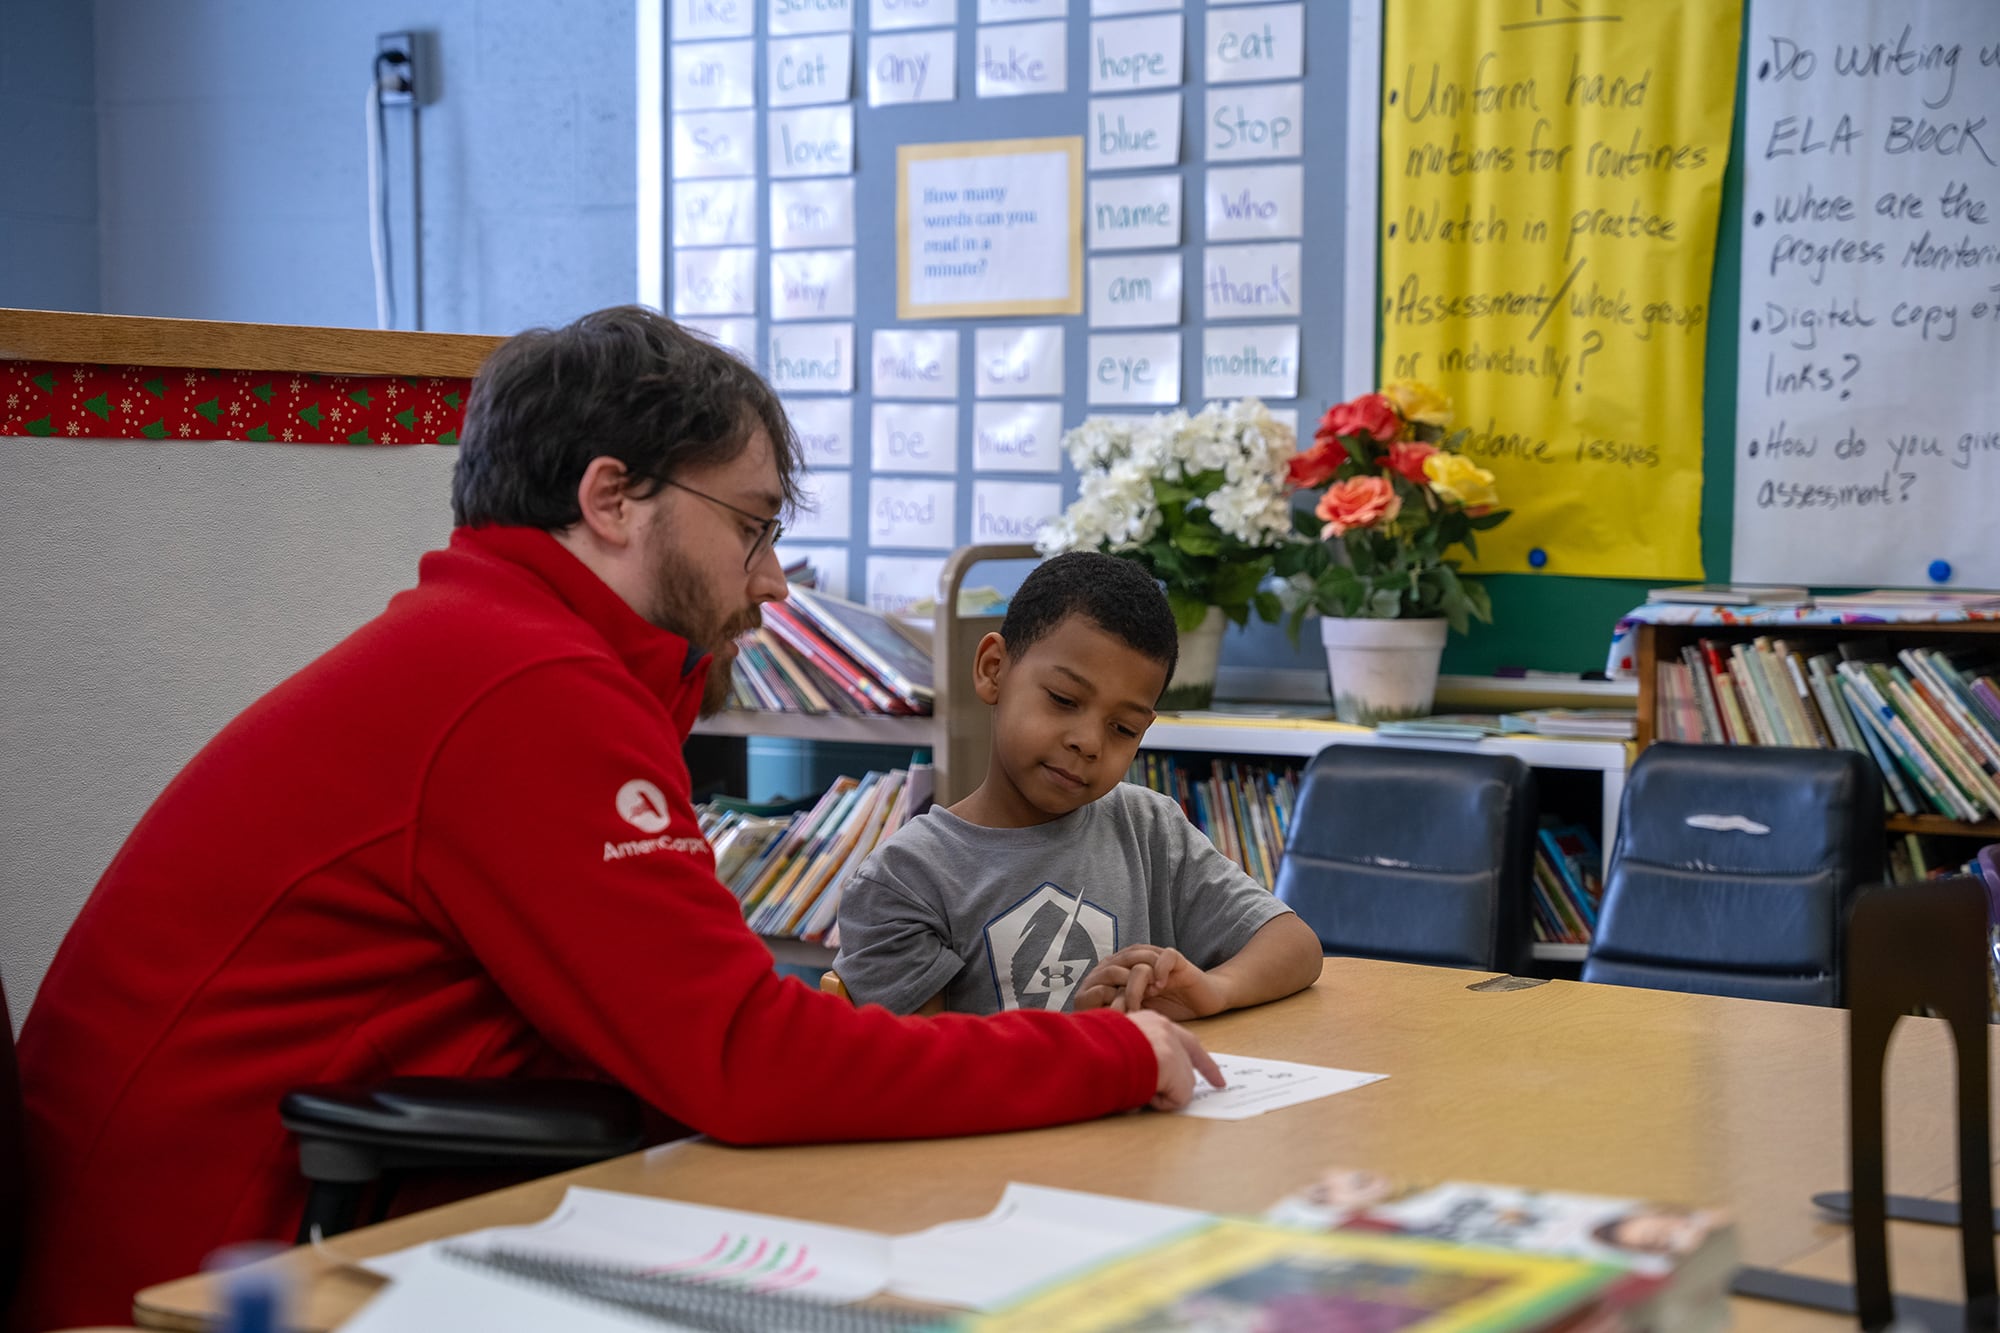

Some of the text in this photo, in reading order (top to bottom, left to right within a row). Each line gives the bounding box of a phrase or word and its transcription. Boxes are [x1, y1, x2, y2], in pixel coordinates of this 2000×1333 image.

[980, 44, 1048, 82] take
[1096, 36, 1168, 84] hope
[1217, 22, 1276, 64] eat
[877, 50, 932, 100] any
[1403, 51, 1652, 123] Uniform hand
[1769, 36, 1817, 82] Do
[1834, 23, 1962, 110] writing
[780, 122, 841, 168] love
[1097, 112, 1160, 155] blue
[1525, 118, 1573, 175] for
[1586, 127, 1708, 179] routines
[1765, 113, 1865, 161] ELA
[923, 186, 1008, 207] How many
[1094, 202, 1171, 232] name
[1875, 192, 1924, 220] are
[1939, 180, 1990, 225] the
[922, 210, 1038, 230] words can you
[1405, 199, 1677, 263] Watch in practice
[923, 235, 992, 254] read in a
[1769, 234, 1886, 286] progress
[1108, 275, 1153, 305] am
[1206, 263, 1292, 306] thank
[1765, 297, 1877, 350] Digital
[773, 336, 843, 382] hand
[1097, 354, 1152, 393] eye
[1205, 343, 1288, 377] mother
[1394, 351, 1424, 380] or
[1765, 352, 1862, 401] links?
[887, 415, 930, 460] be
[1575, 437, 1661, 469] issues
[1765, 420, 1818, 460] How
[1835, 427, 1867, 460] do
[1887, 433, 1945, 474] you
[1757, 470, 1918, 510] assessment?
[876, 493, 936, 536] good
